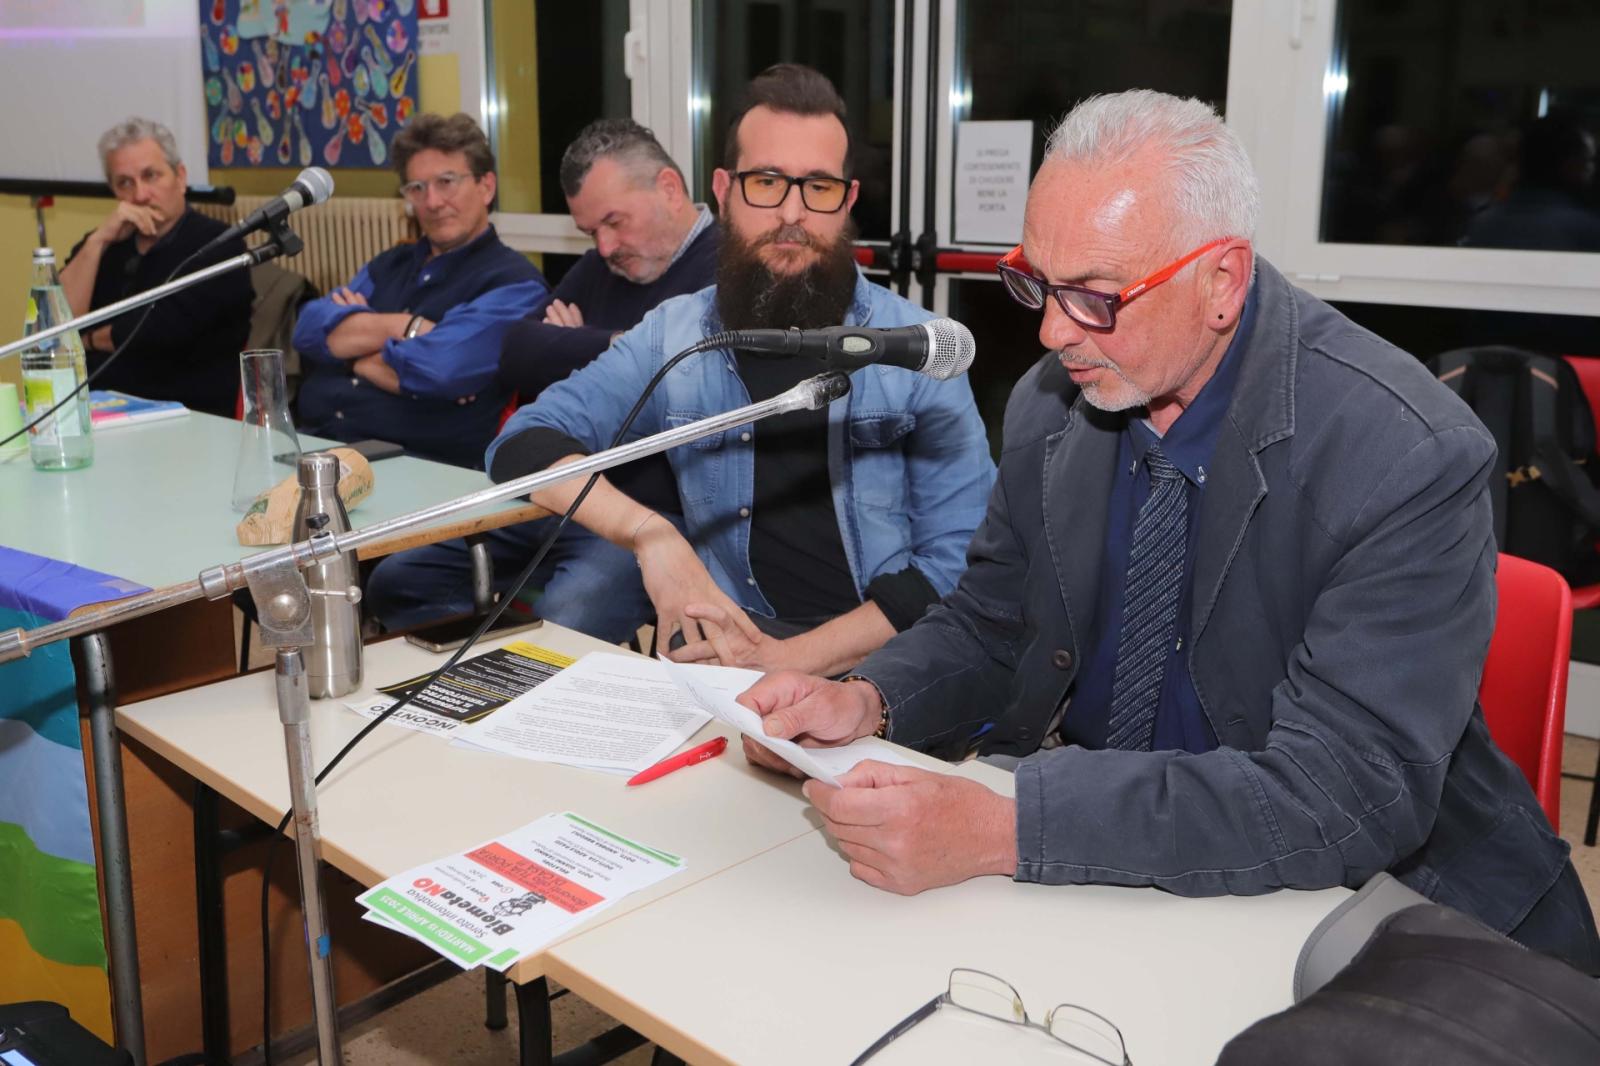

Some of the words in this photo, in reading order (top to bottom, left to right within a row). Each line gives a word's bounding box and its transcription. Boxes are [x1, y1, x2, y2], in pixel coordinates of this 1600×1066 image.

[979, 203, 1006, 212] PORTA
[370, 705, 457, 731] INCONTO
[407, 889, 458, 919] informativa
[412, 878, 515, 936] BiometaNO
[456, 917, 488, 938] Serata
